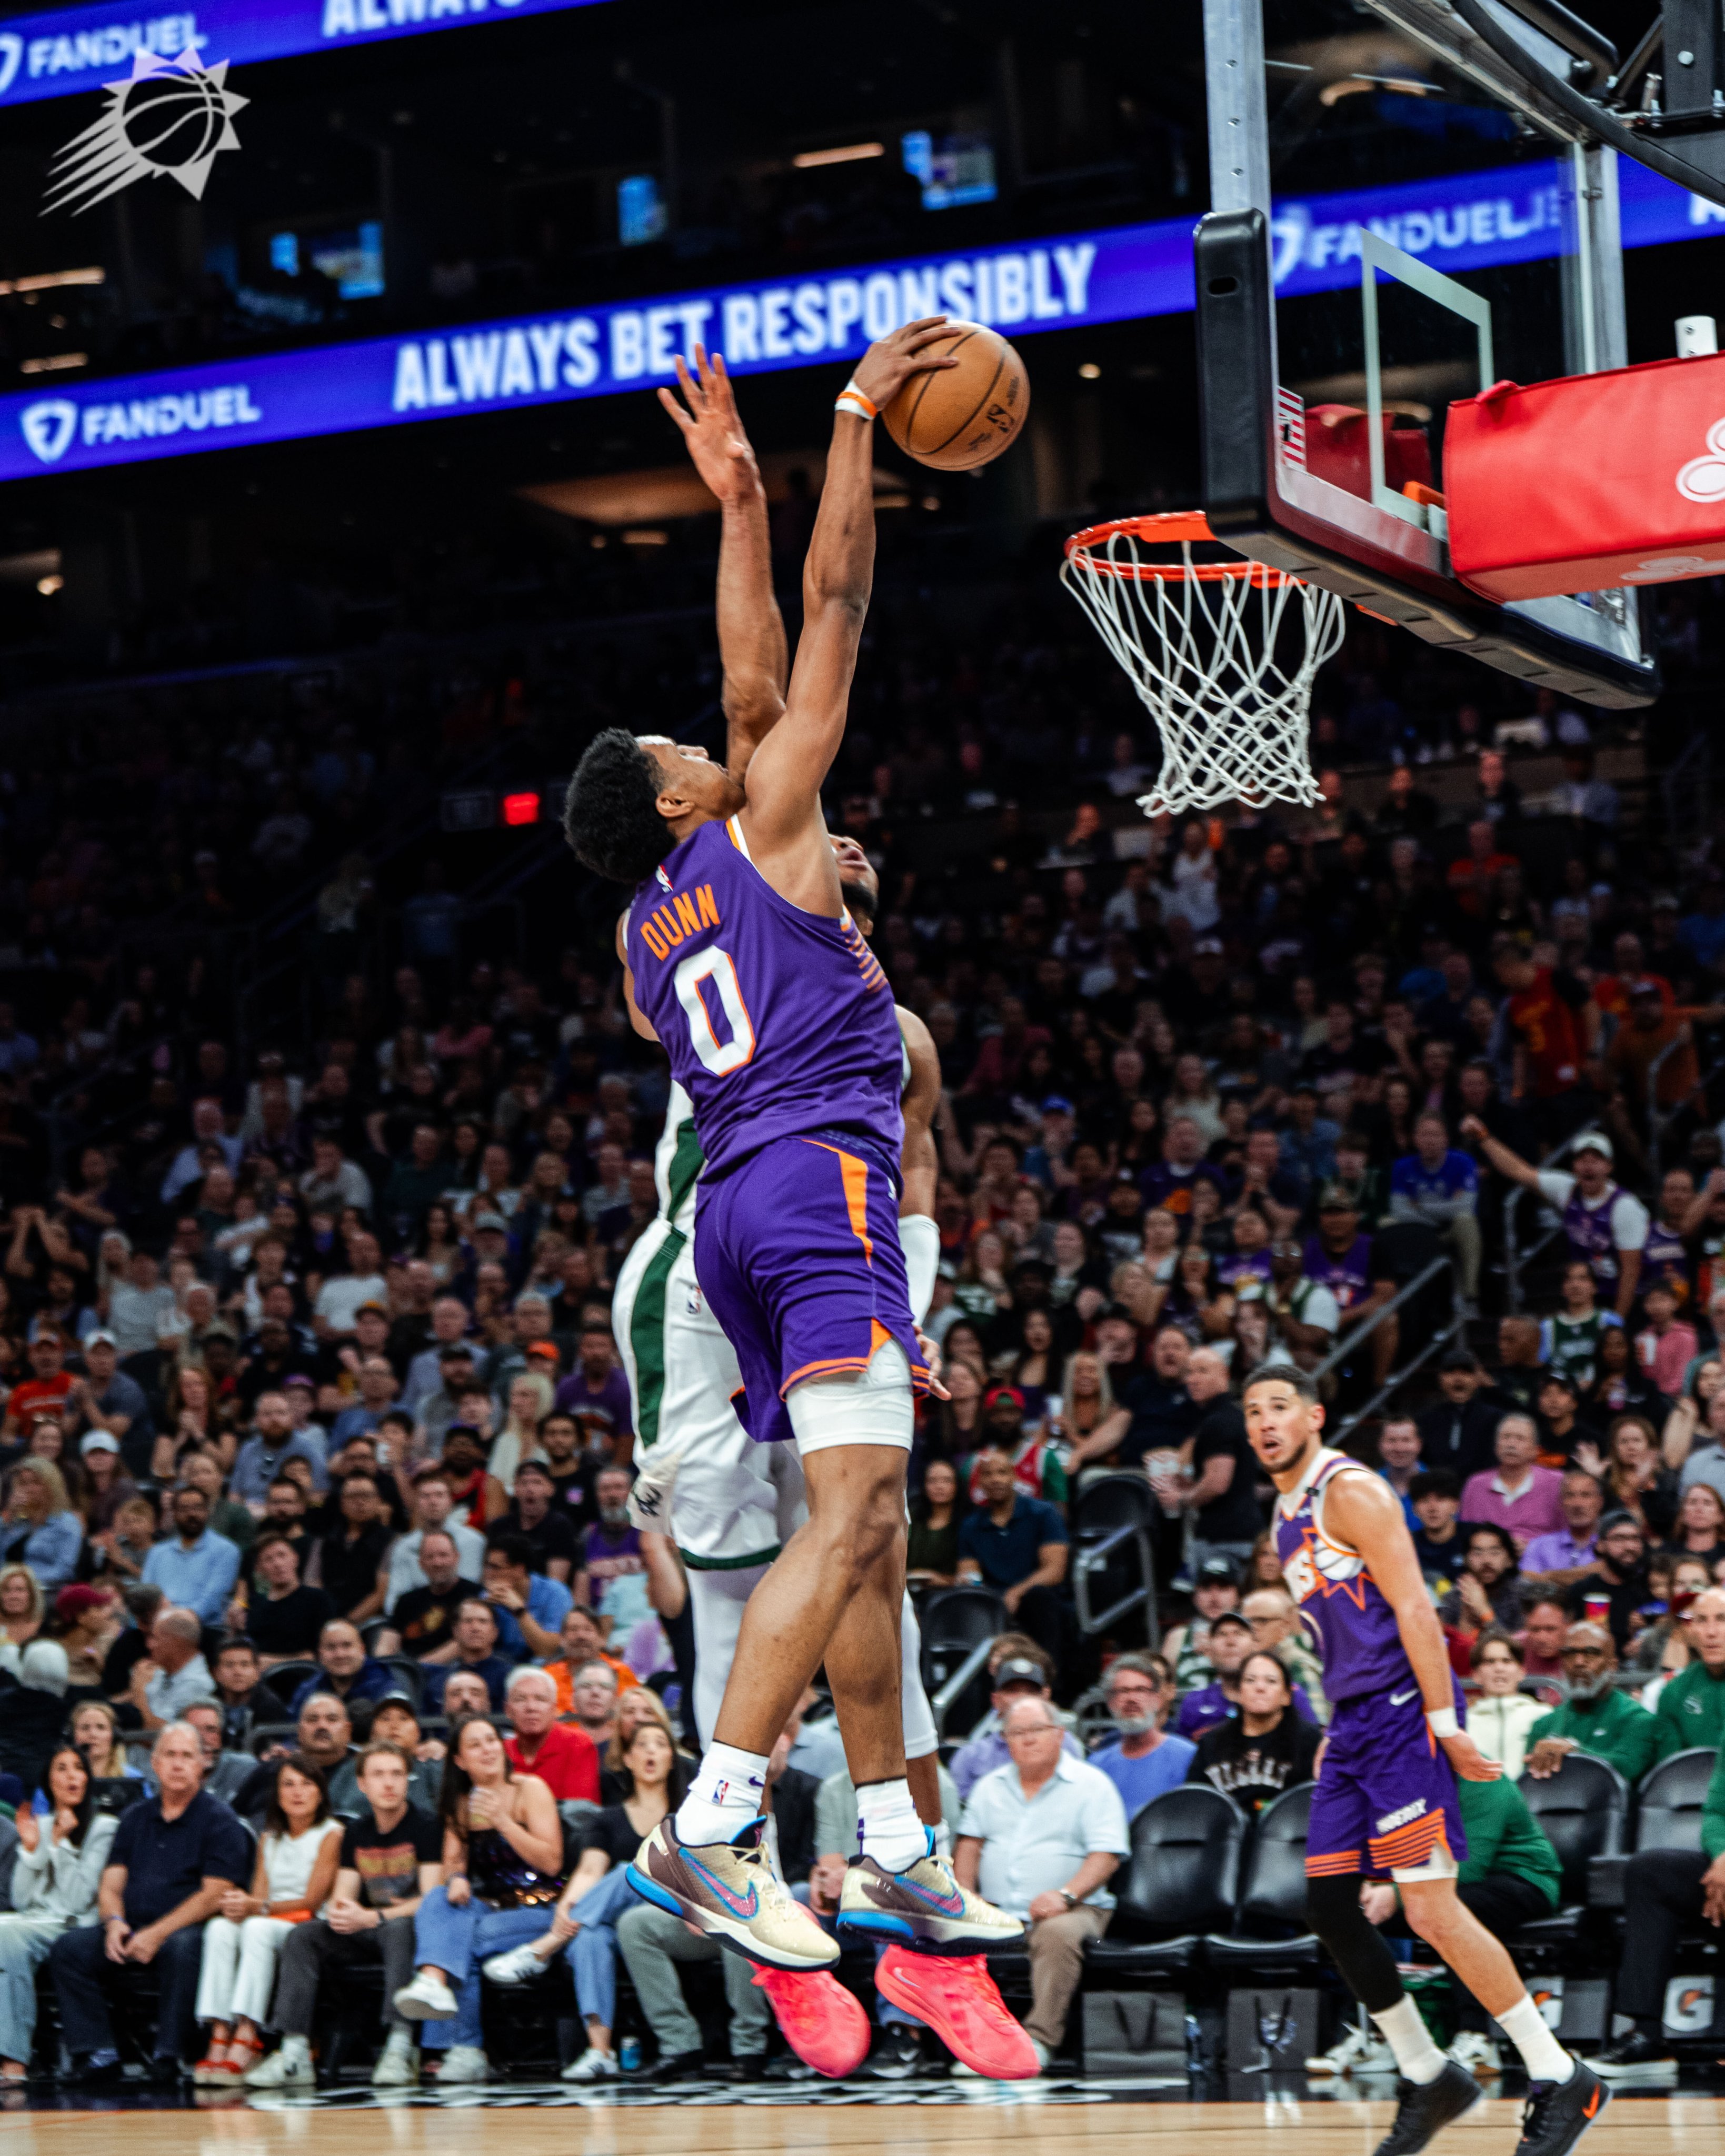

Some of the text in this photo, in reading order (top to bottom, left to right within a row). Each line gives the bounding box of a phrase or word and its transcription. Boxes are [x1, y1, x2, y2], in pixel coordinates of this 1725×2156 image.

[28, 13, 208, 78] FANDUEL
[393, 243, 1096, 412] ALWAYS BET RESPONSIBLY
[82, 384, 262, 447] FANDUEL
[640, 884, 721, 961] DUNN
[674, 945, 756, 1077] 0
